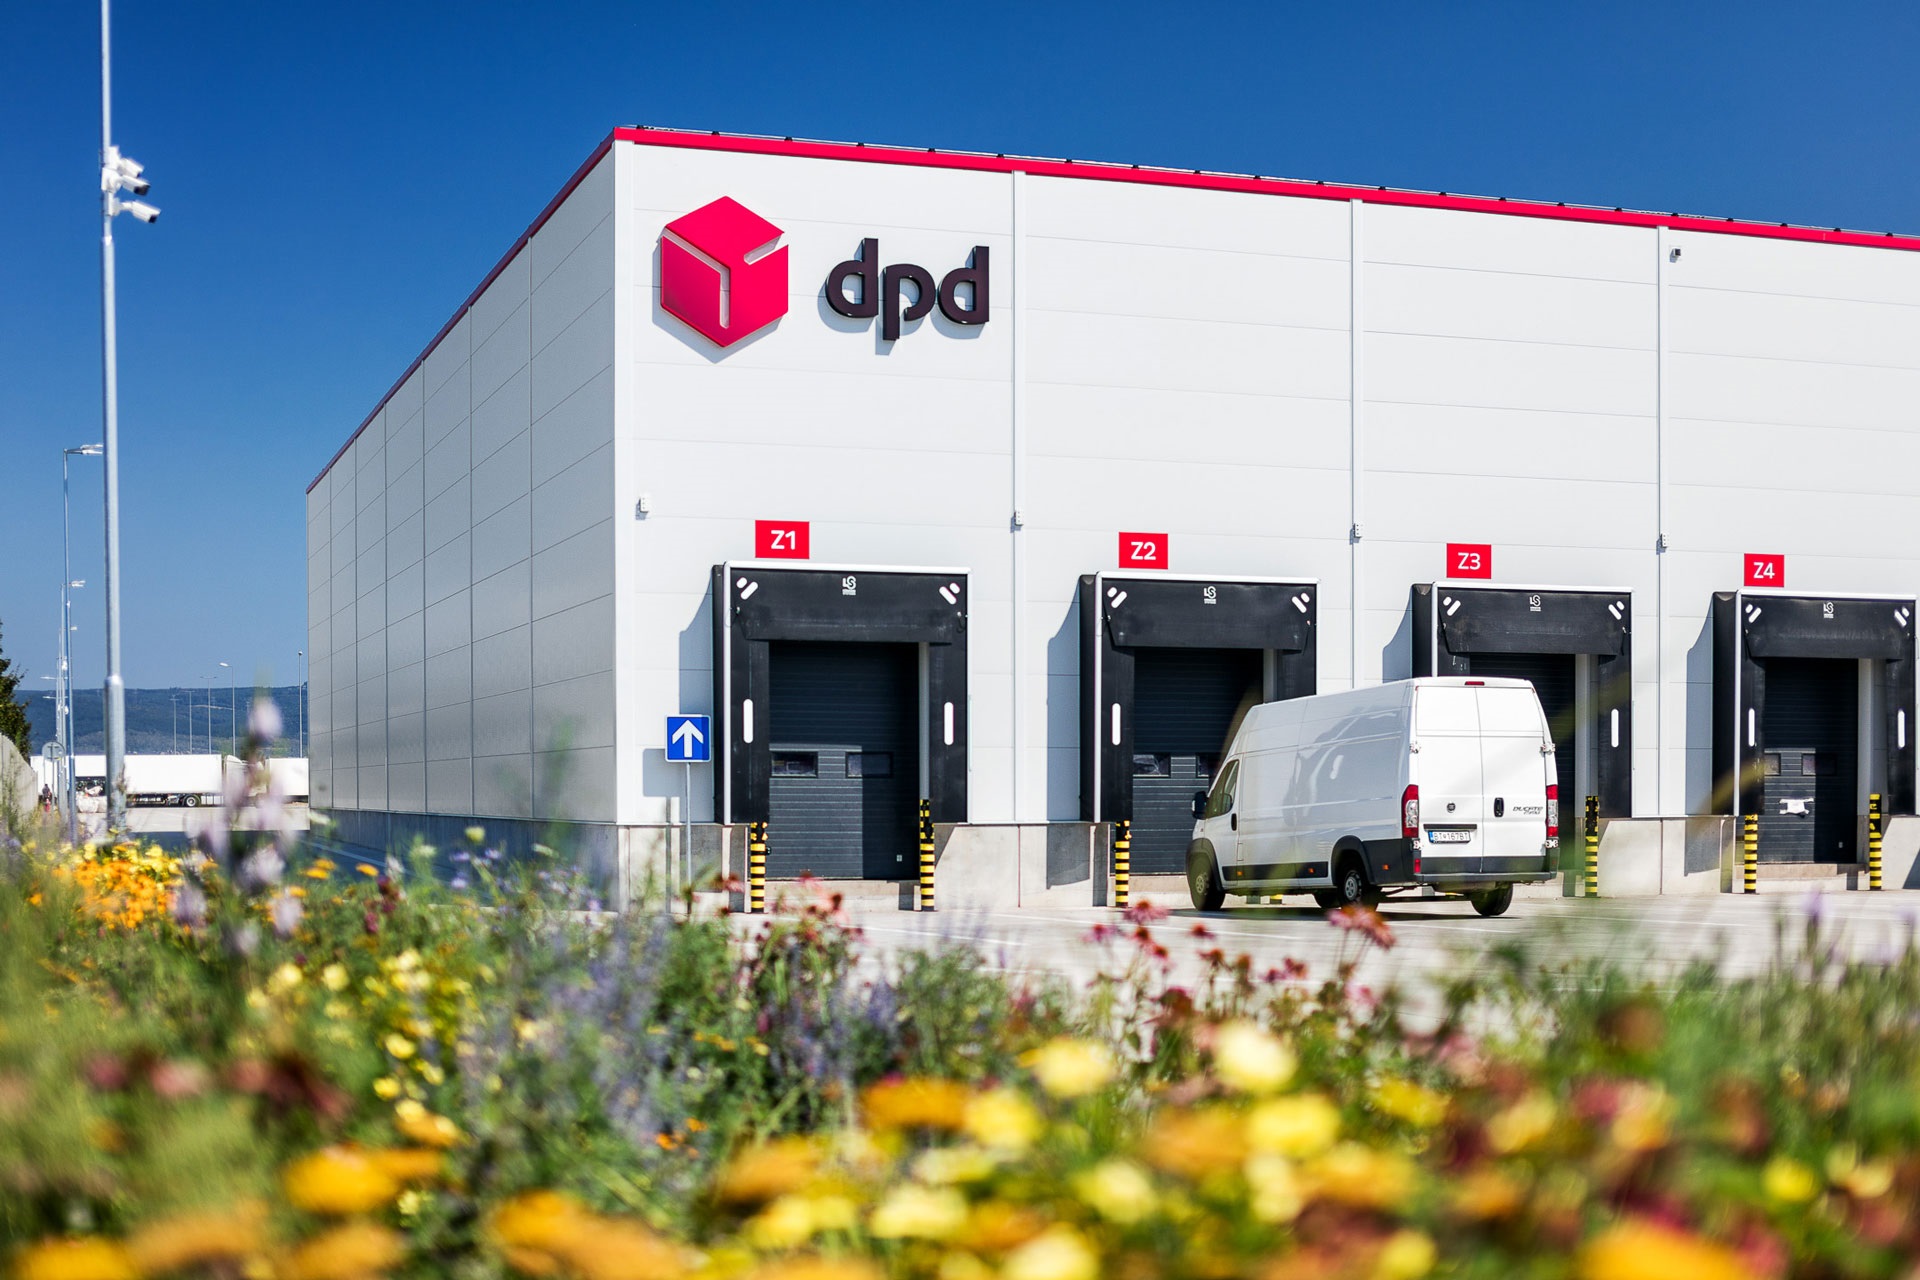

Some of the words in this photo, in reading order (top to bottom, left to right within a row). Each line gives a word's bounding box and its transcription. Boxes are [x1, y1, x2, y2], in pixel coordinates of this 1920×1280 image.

[824, 237, 990, 342] dpd
[770, 529, 796, 550] Z1
[1130, 541, 1157, 561] Z2
[1457, 552, 1481, 571] Z3
[1753, 561, 1776, 580] Z4
